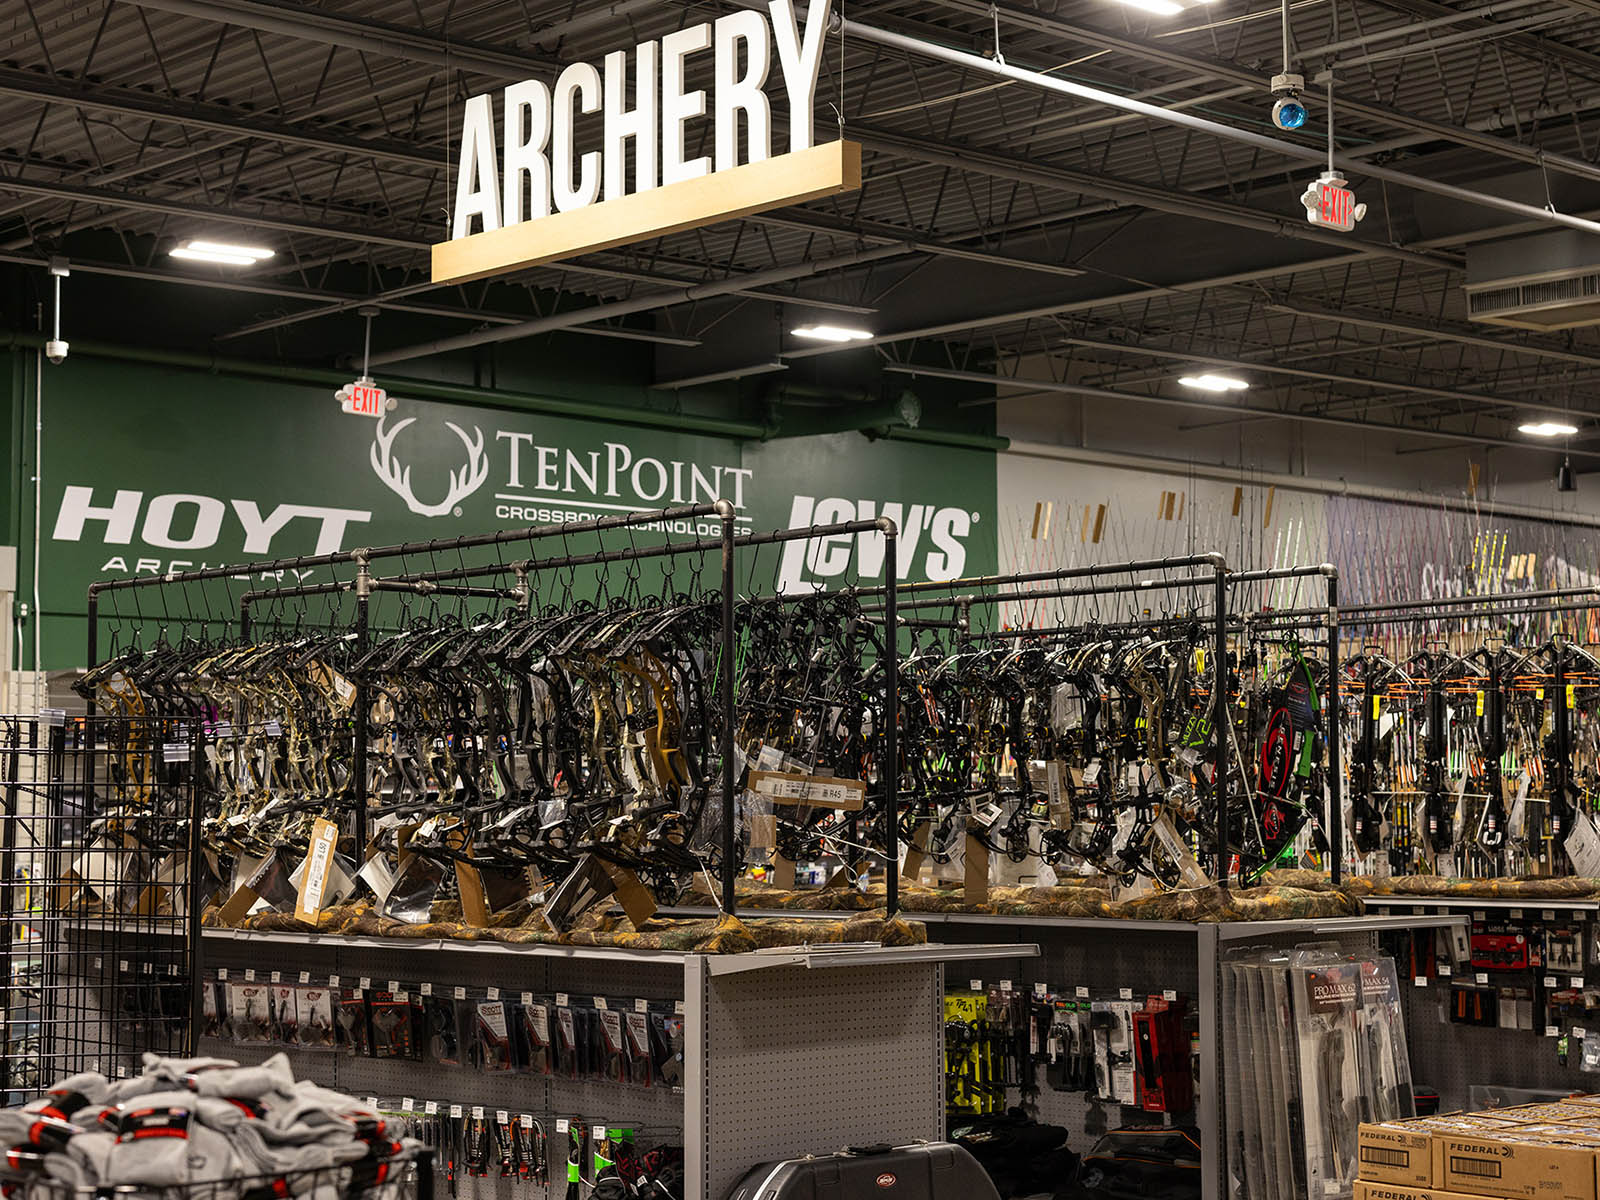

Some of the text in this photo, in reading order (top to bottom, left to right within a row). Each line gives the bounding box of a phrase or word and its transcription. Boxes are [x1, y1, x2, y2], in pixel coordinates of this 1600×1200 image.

[452, 0, 832, 240] ARCHERY
[1322, 186, 1351, 226] EXIT
[353, 386, 381, 414] EXIT
[52, 485, 372, 556] HOYT
[1360, 1132, 1396, 1142] FEDERAL
[1450, 1143, 1499, 1156] FEDERAL
